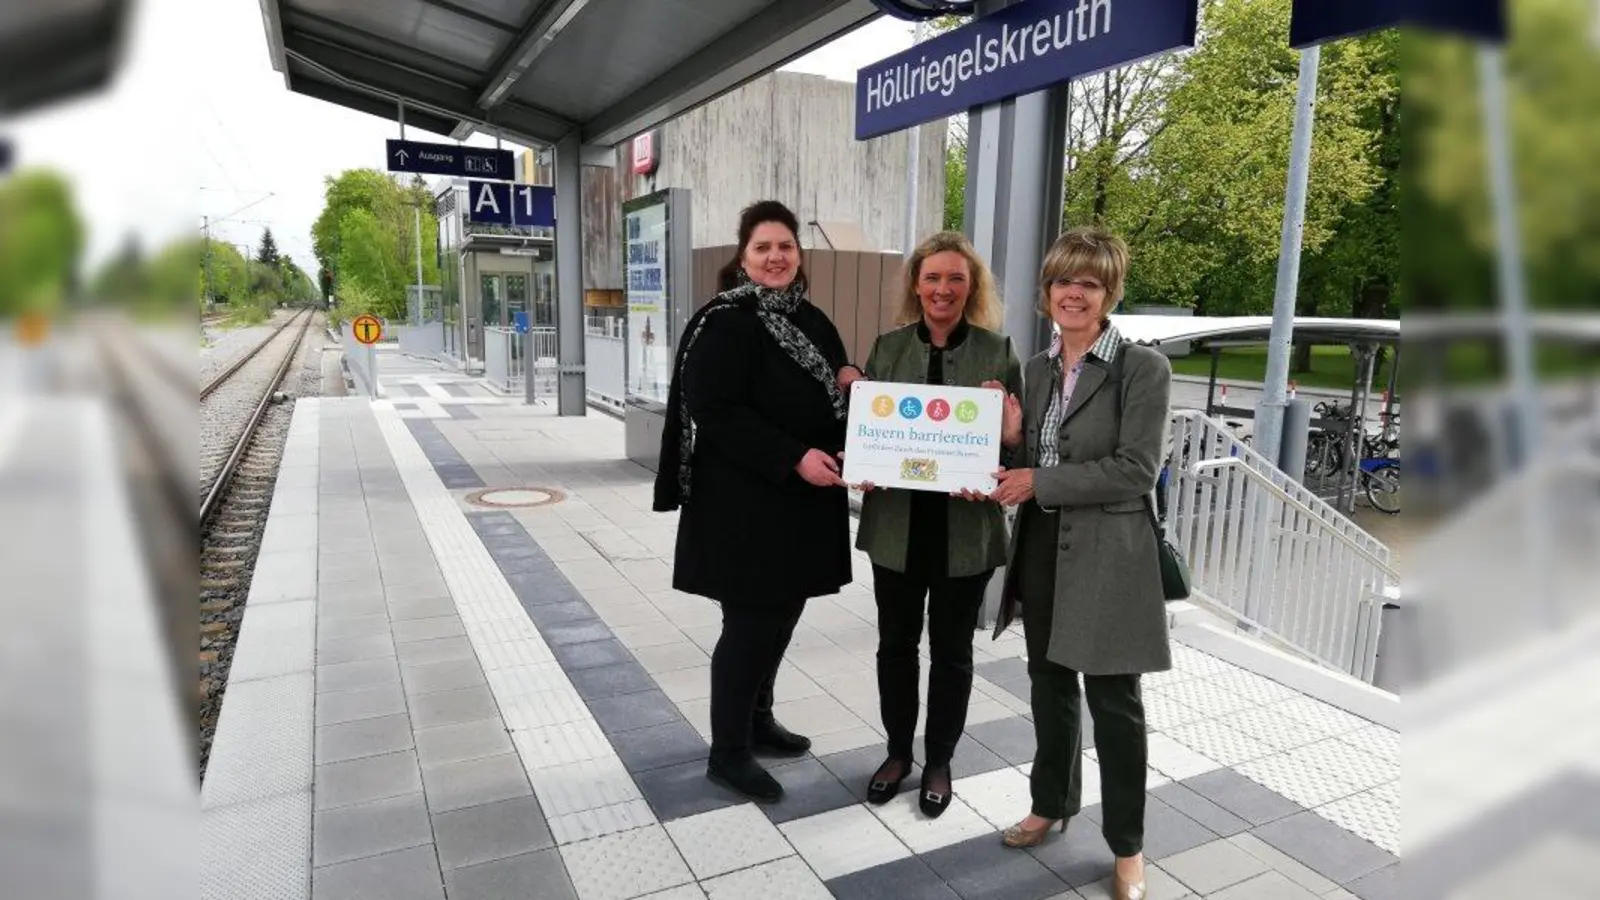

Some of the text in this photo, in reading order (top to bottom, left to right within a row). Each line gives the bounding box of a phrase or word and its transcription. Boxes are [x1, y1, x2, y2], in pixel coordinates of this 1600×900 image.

[866, 0, 1112, 113] Höllriegelskreuth
[418, 150, 454, 164] Ausgang
[474, 183, 533, 217] A 1
[857, 423, 989, 447] Bayern barrierefrei
